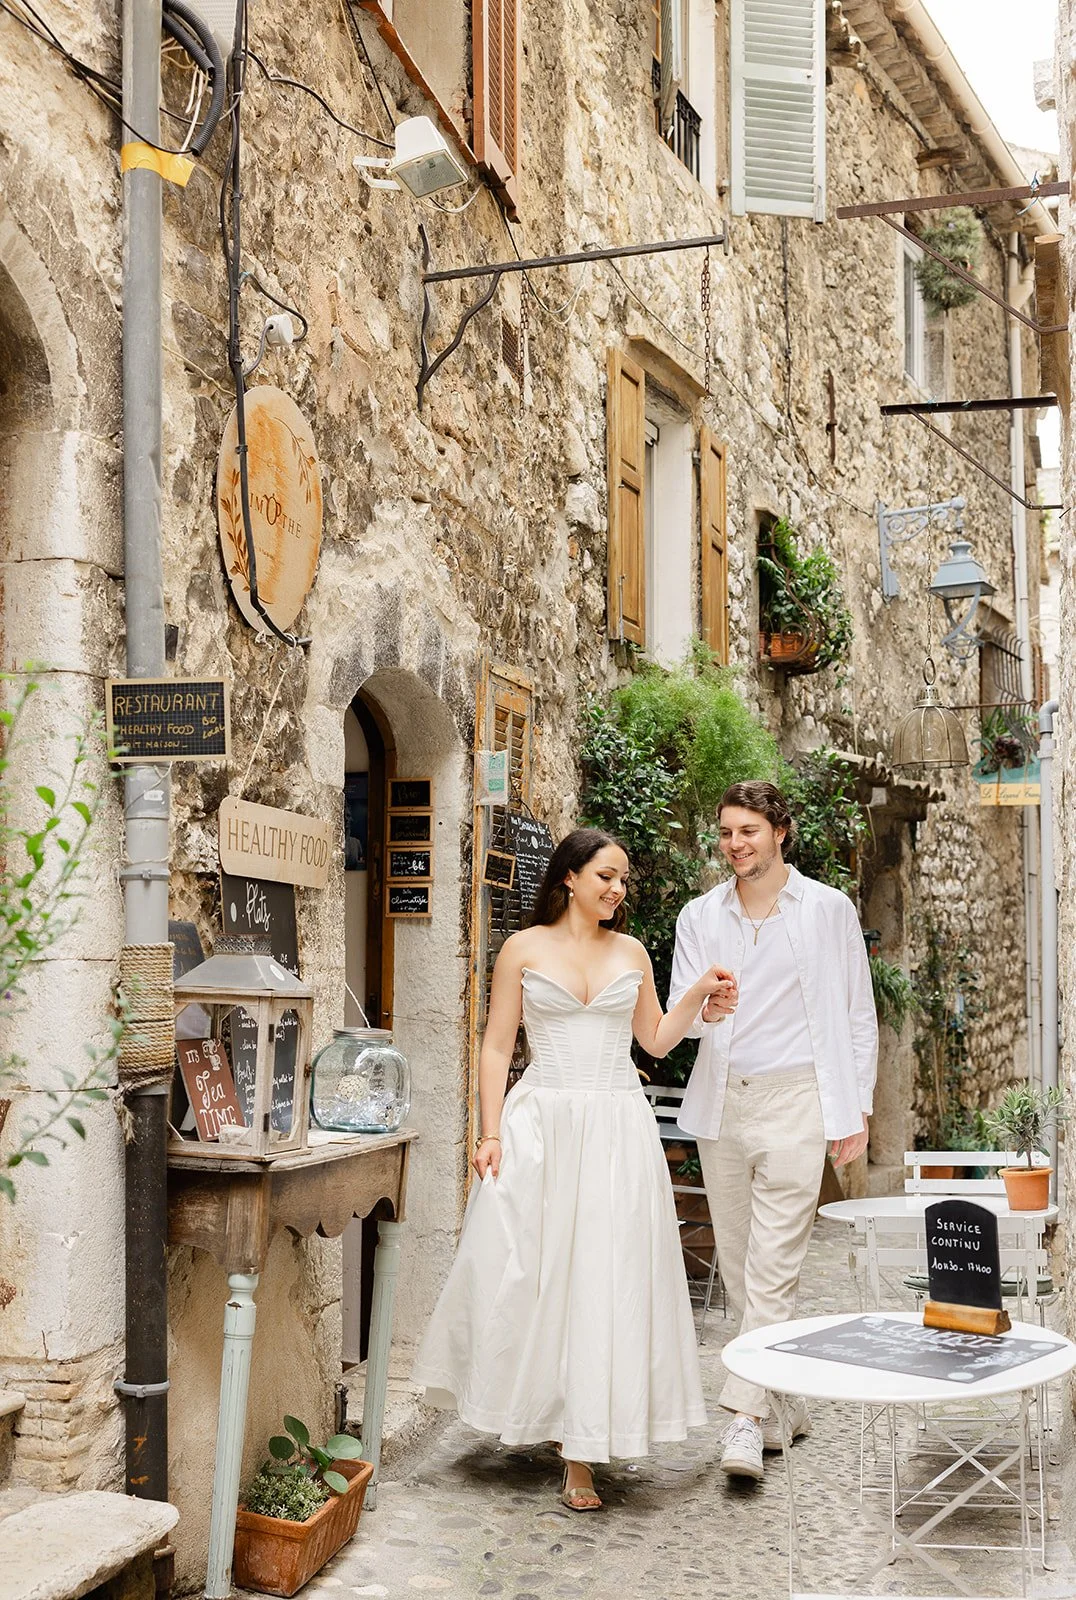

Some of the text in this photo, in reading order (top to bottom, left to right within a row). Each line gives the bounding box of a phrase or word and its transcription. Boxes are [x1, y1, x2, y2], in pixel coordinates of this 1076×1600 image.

[114, 693, 219, 716] RESTAURANT
[119, 723, 195, 736] HEALTHY FOOD
[227, 817, 328, 869] HEALTHY FOOD
[408, 860, 426, 871] blé
[246, 881, 271, 932] Plats
[196, 1070, 226, 1109] Tea
